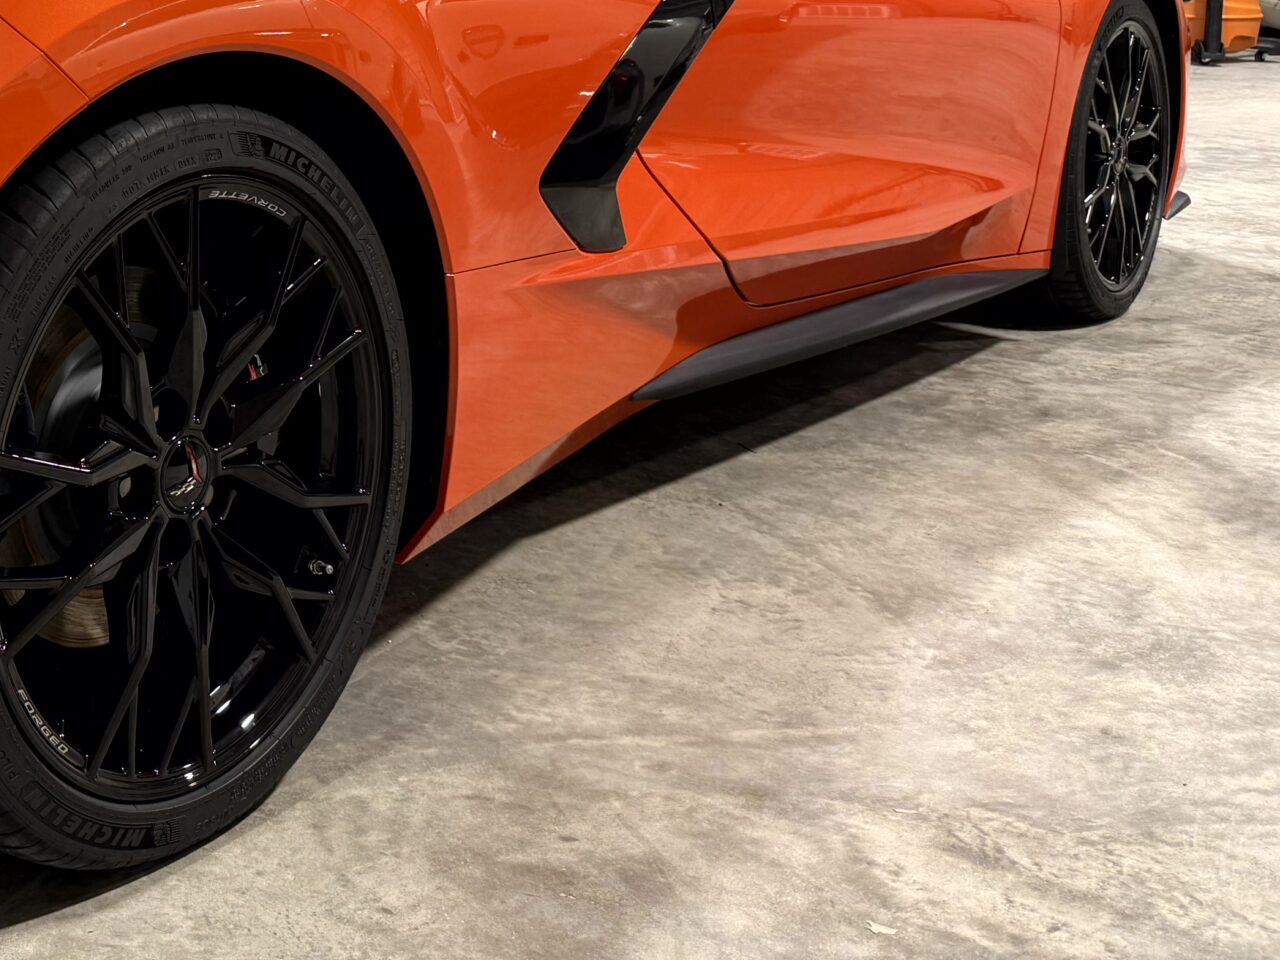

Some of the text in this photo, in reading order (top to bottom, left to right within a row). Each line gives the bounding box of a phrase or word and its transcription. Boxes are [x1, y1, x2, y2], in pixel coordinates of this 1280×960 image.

[207, 190, 288, 217] CORVETTE
[269, 142, 362, 228] MICHELIN
[17, 688, 70, 754] FORGED
[23, 787, 149, 849] MICHELIN
